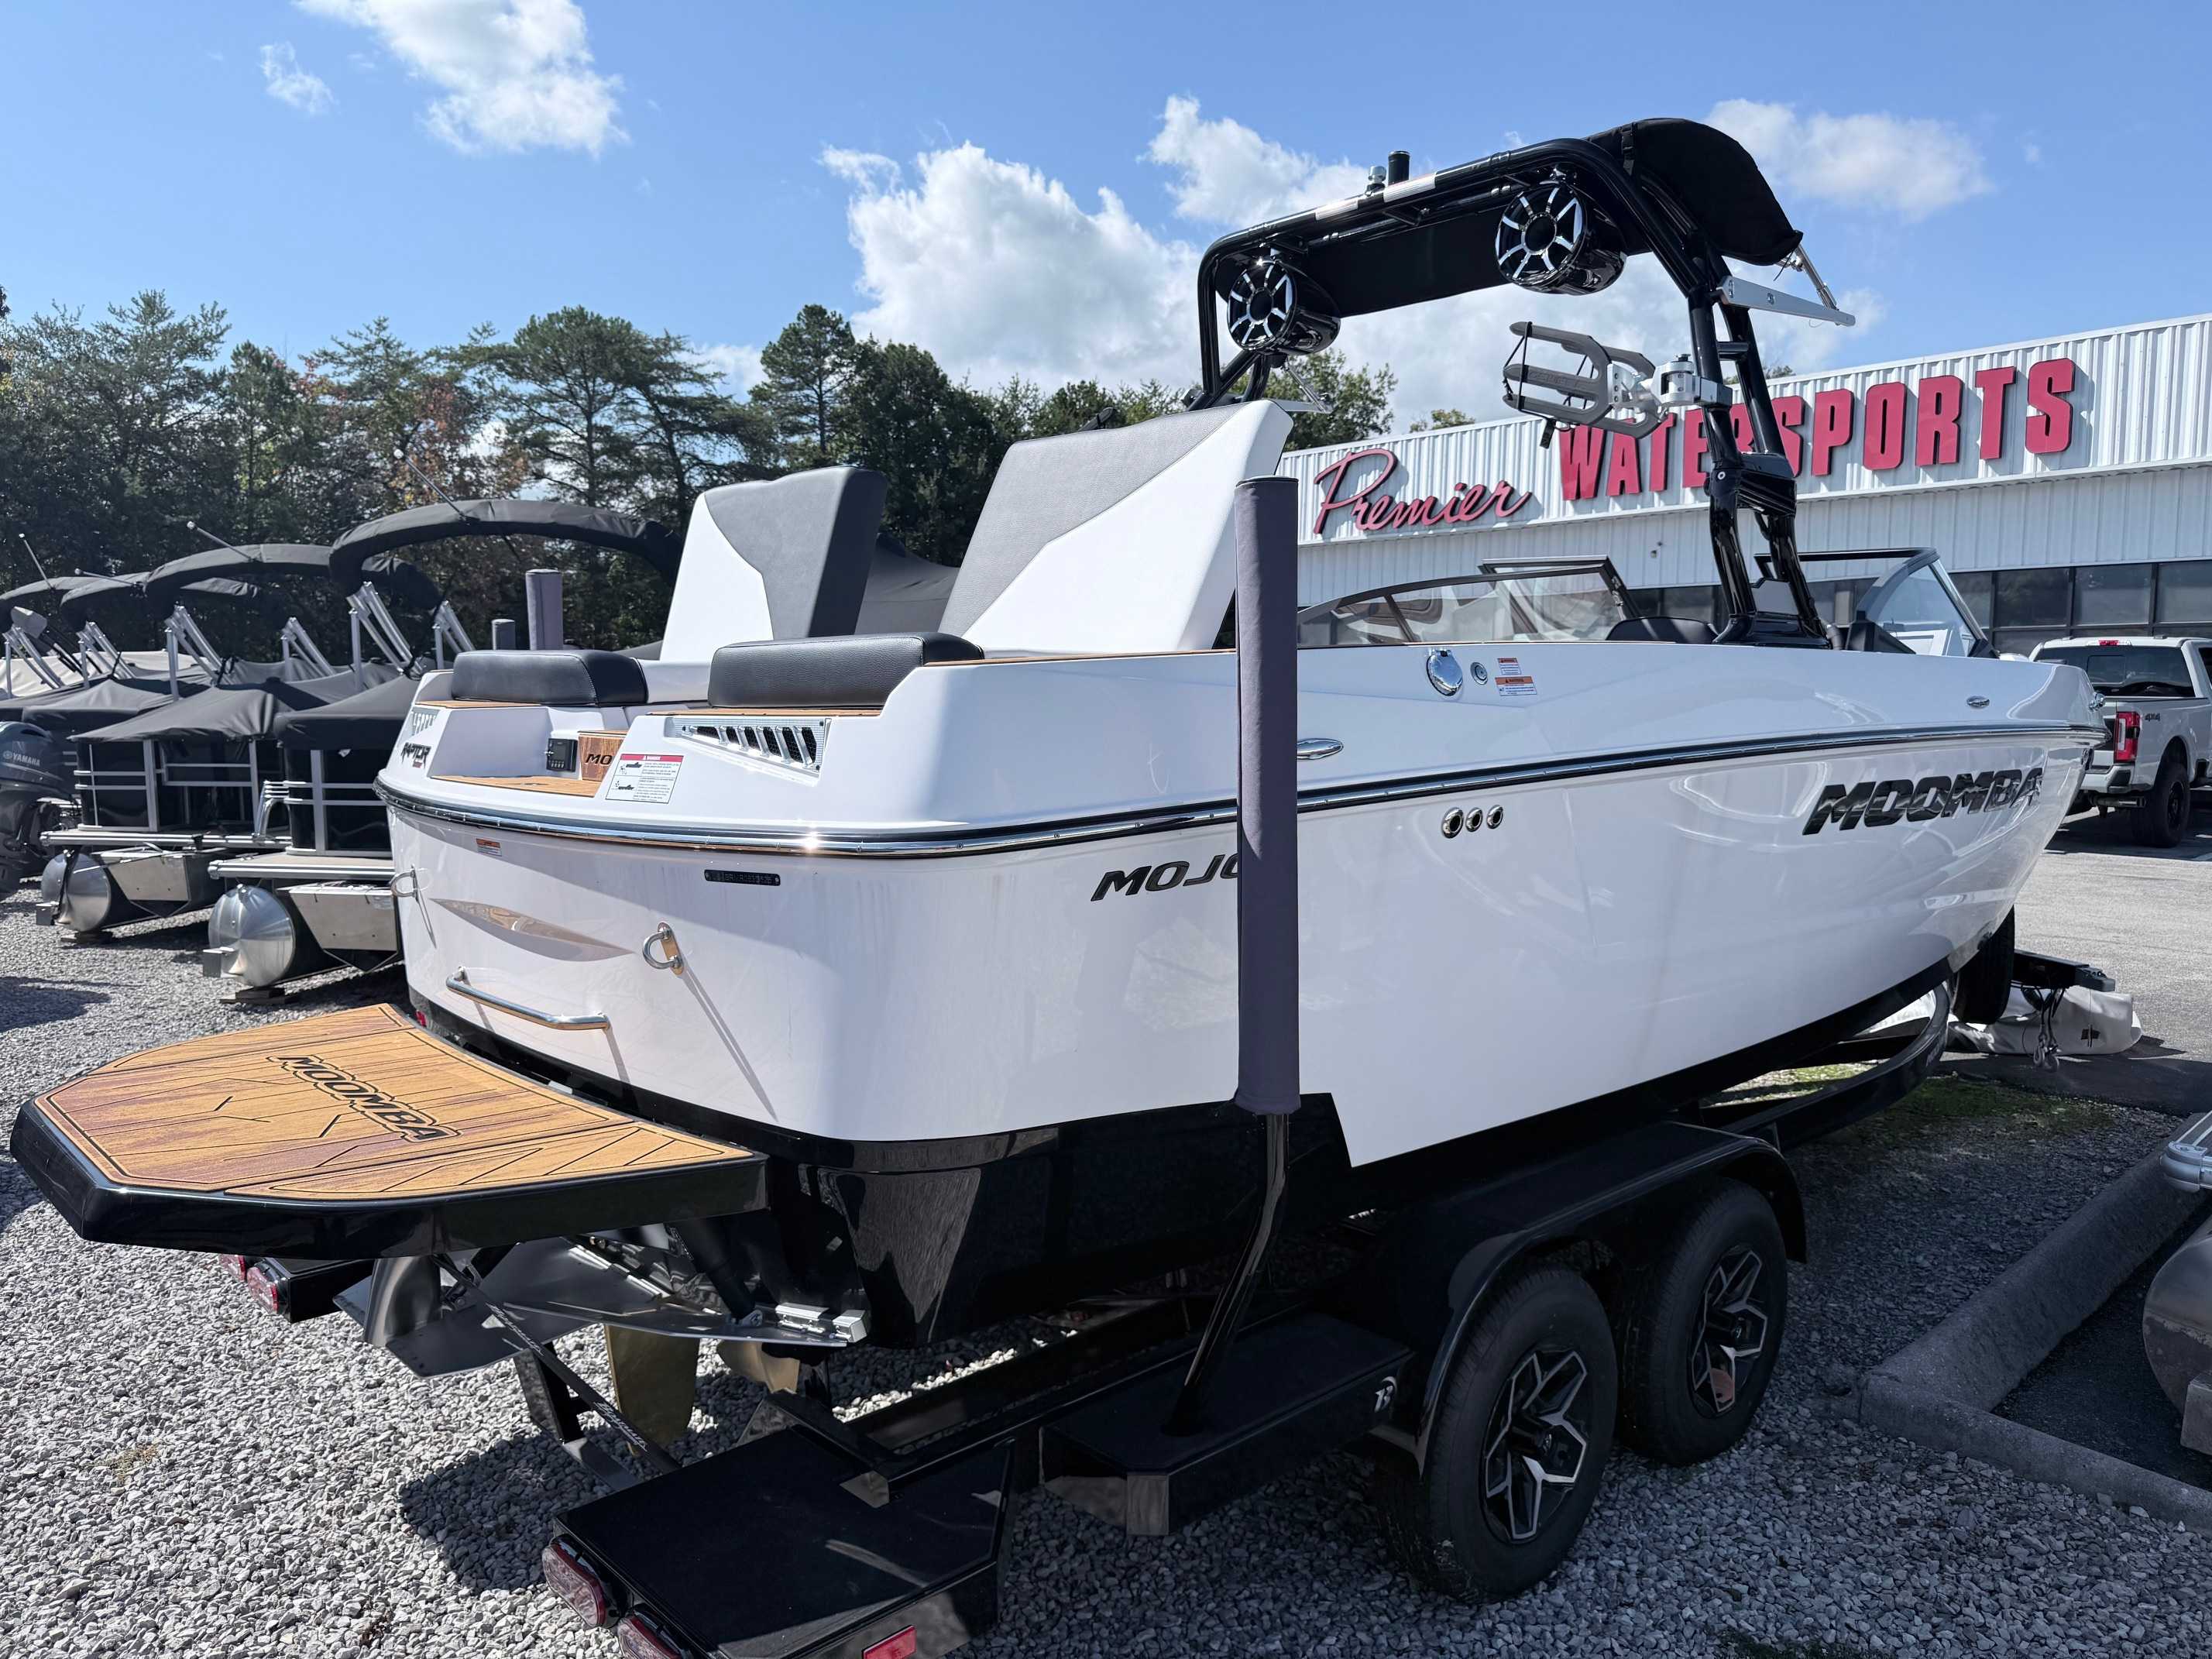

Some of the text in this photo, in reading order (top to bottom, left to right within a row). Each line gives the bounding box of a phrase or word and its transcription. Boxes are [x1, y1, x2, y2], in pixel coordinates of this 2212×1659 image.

[1313, 448, 1533, 534] Premier
[12, 752, 40, 767] YAMAHA
[1802, 768, 2043, 836] MOOMBA
[276, 1056, 450, 1141] MOOMBA
